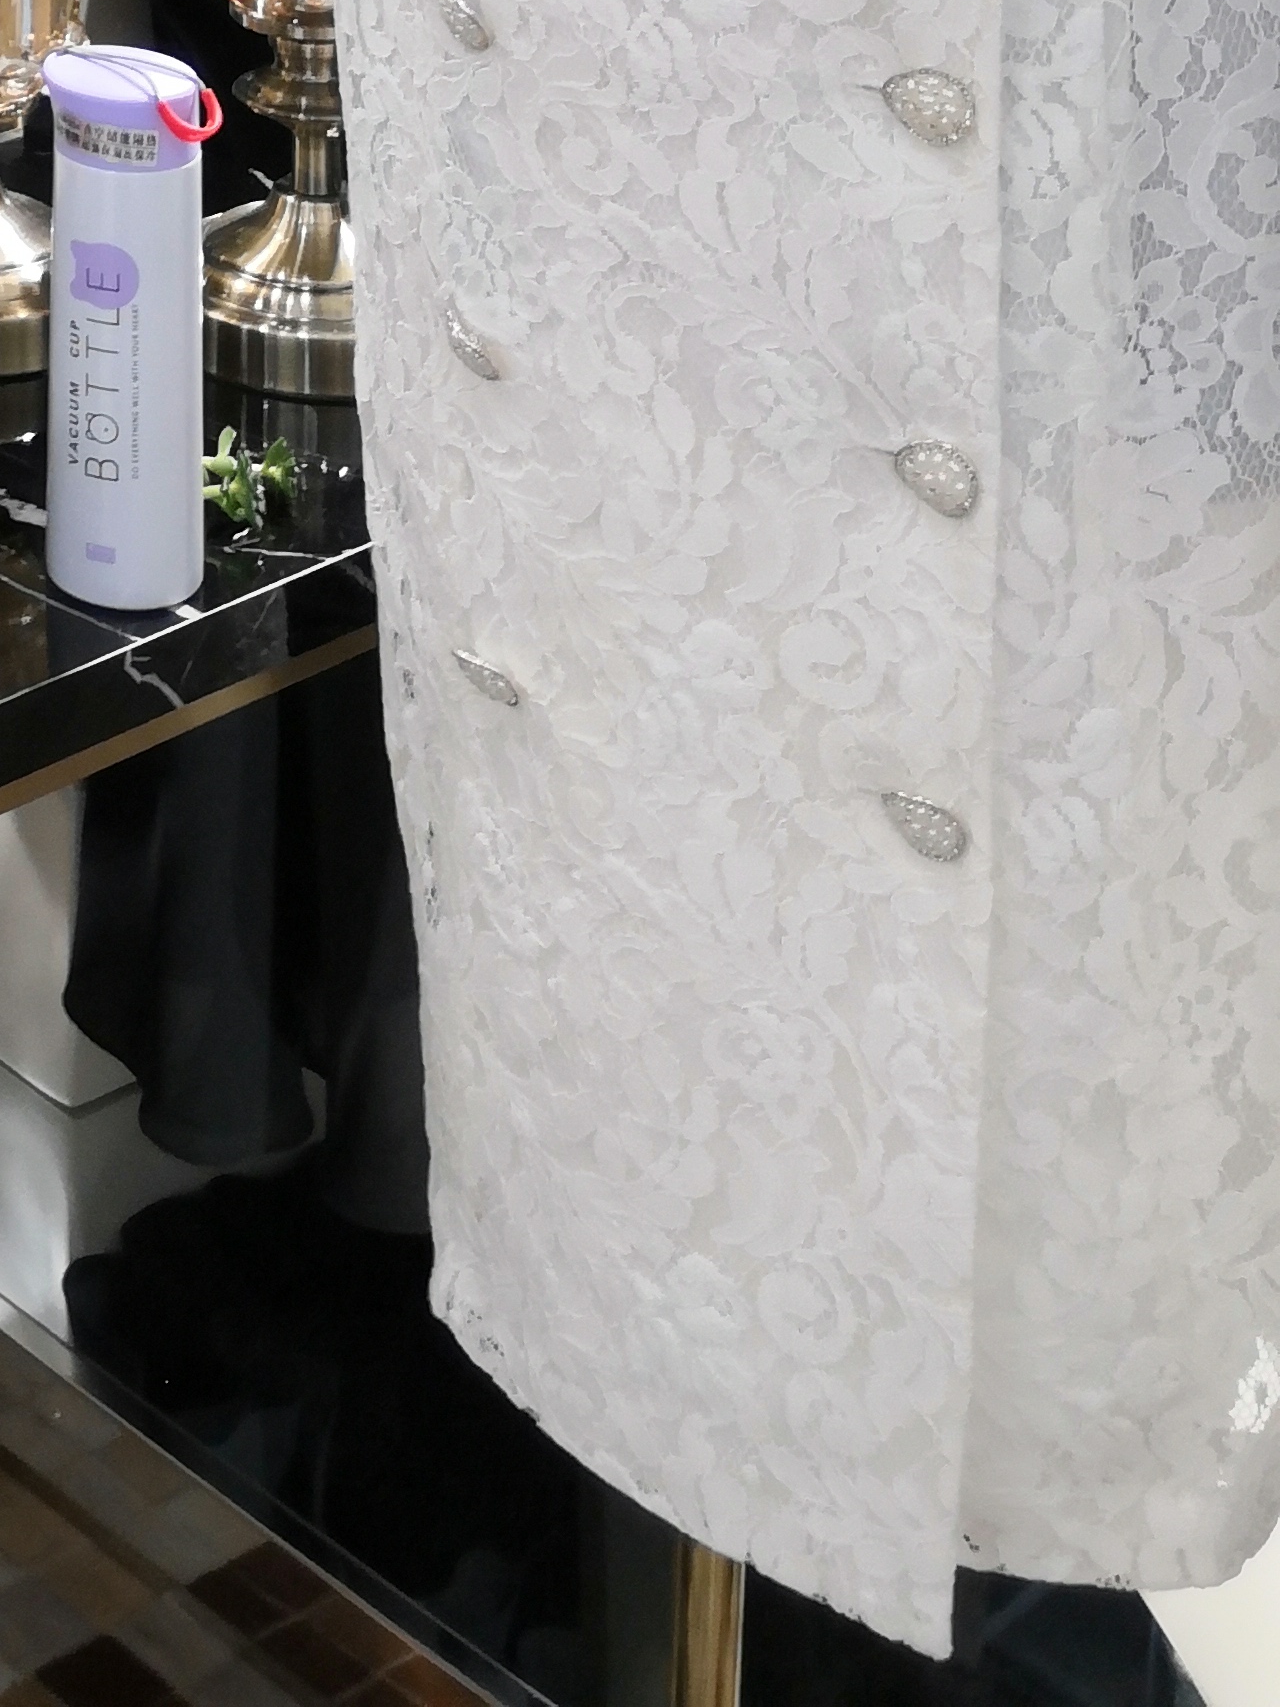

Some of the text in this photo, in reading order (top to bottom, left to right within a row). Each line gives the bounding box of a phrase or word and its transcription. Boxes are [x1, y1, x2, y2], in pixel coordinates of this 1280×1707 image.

[131, 334, 139, 357] YOUR
[84, 267, 120, 482] BOTTLE
[131, 360, 139, 383] WITH
[68, 319, 80, 465] VACUUM CUP
[131, 385, 139, 408] WELL
[131, 411, 139, 464] EVERYTHING
[131, 466, 139, 480] DO
